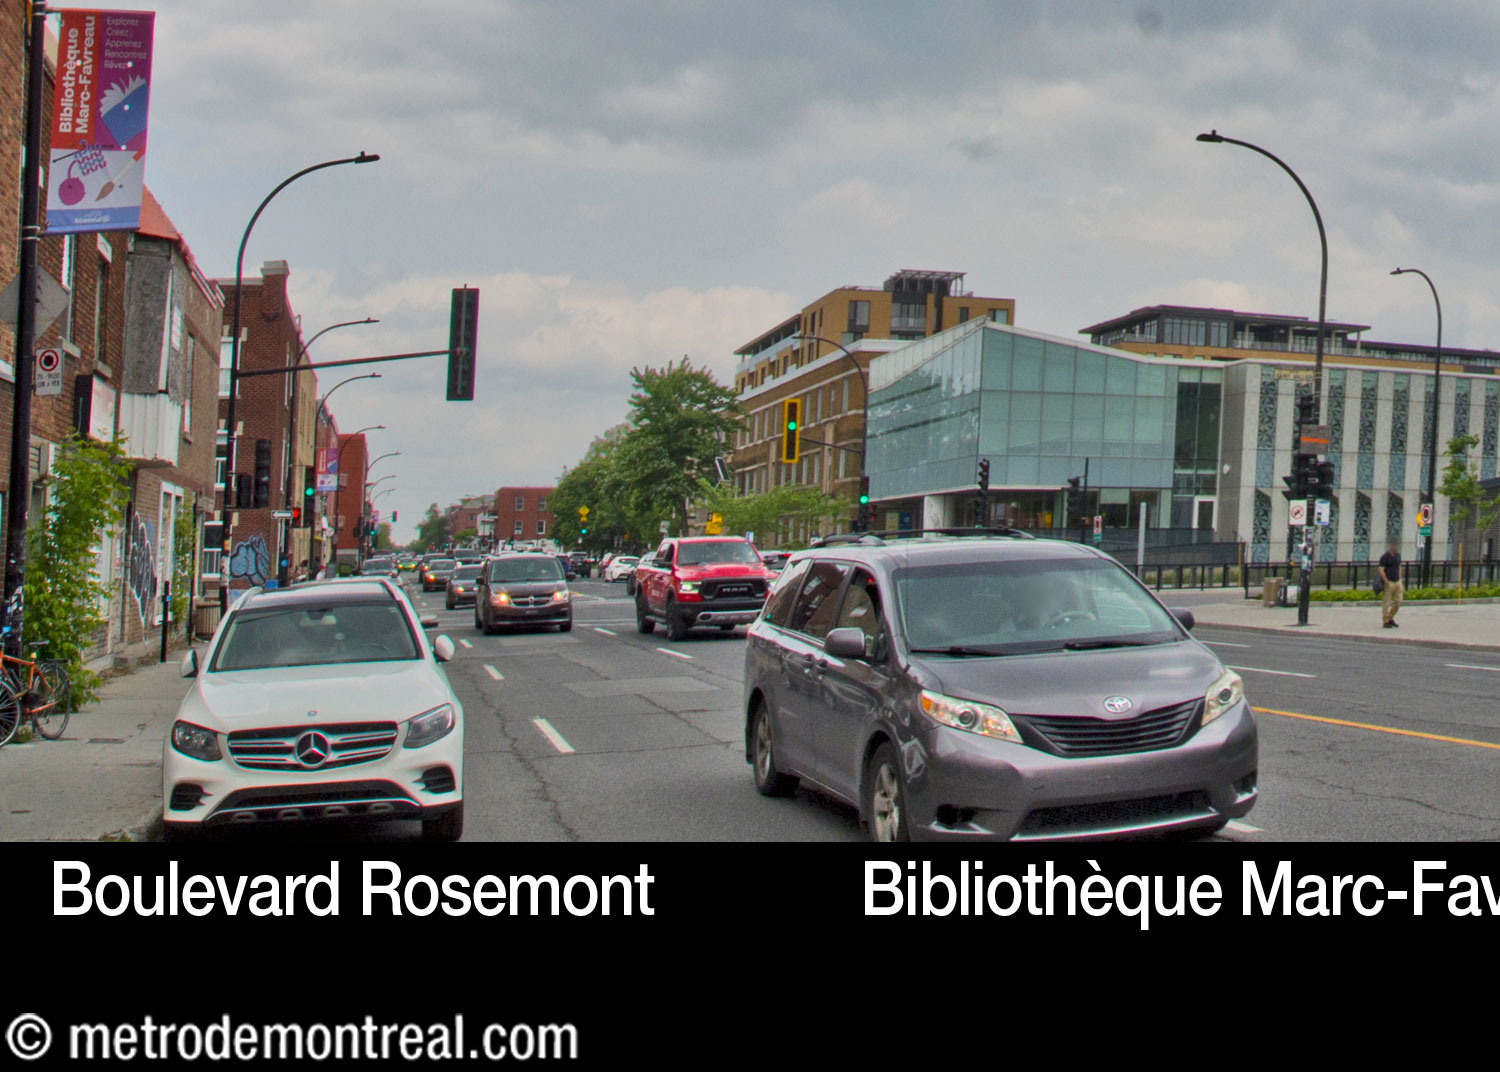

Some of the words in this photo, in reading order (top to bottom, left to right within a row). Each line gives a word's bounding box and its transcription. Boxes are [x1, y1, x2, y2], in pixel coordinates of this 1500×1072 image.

[106, 17, 139, 26] Explorez
[105, 27, 129, 36] Créez
[105, 38, 143, 48] Apprenez
[104, 49, 148, 59] Rencontrez
[103, 60, 126, 69] Rêvez
[75, 15, 97, 134] Marc-Favreau
[59, 27, 80, 133] Bibliothèque
